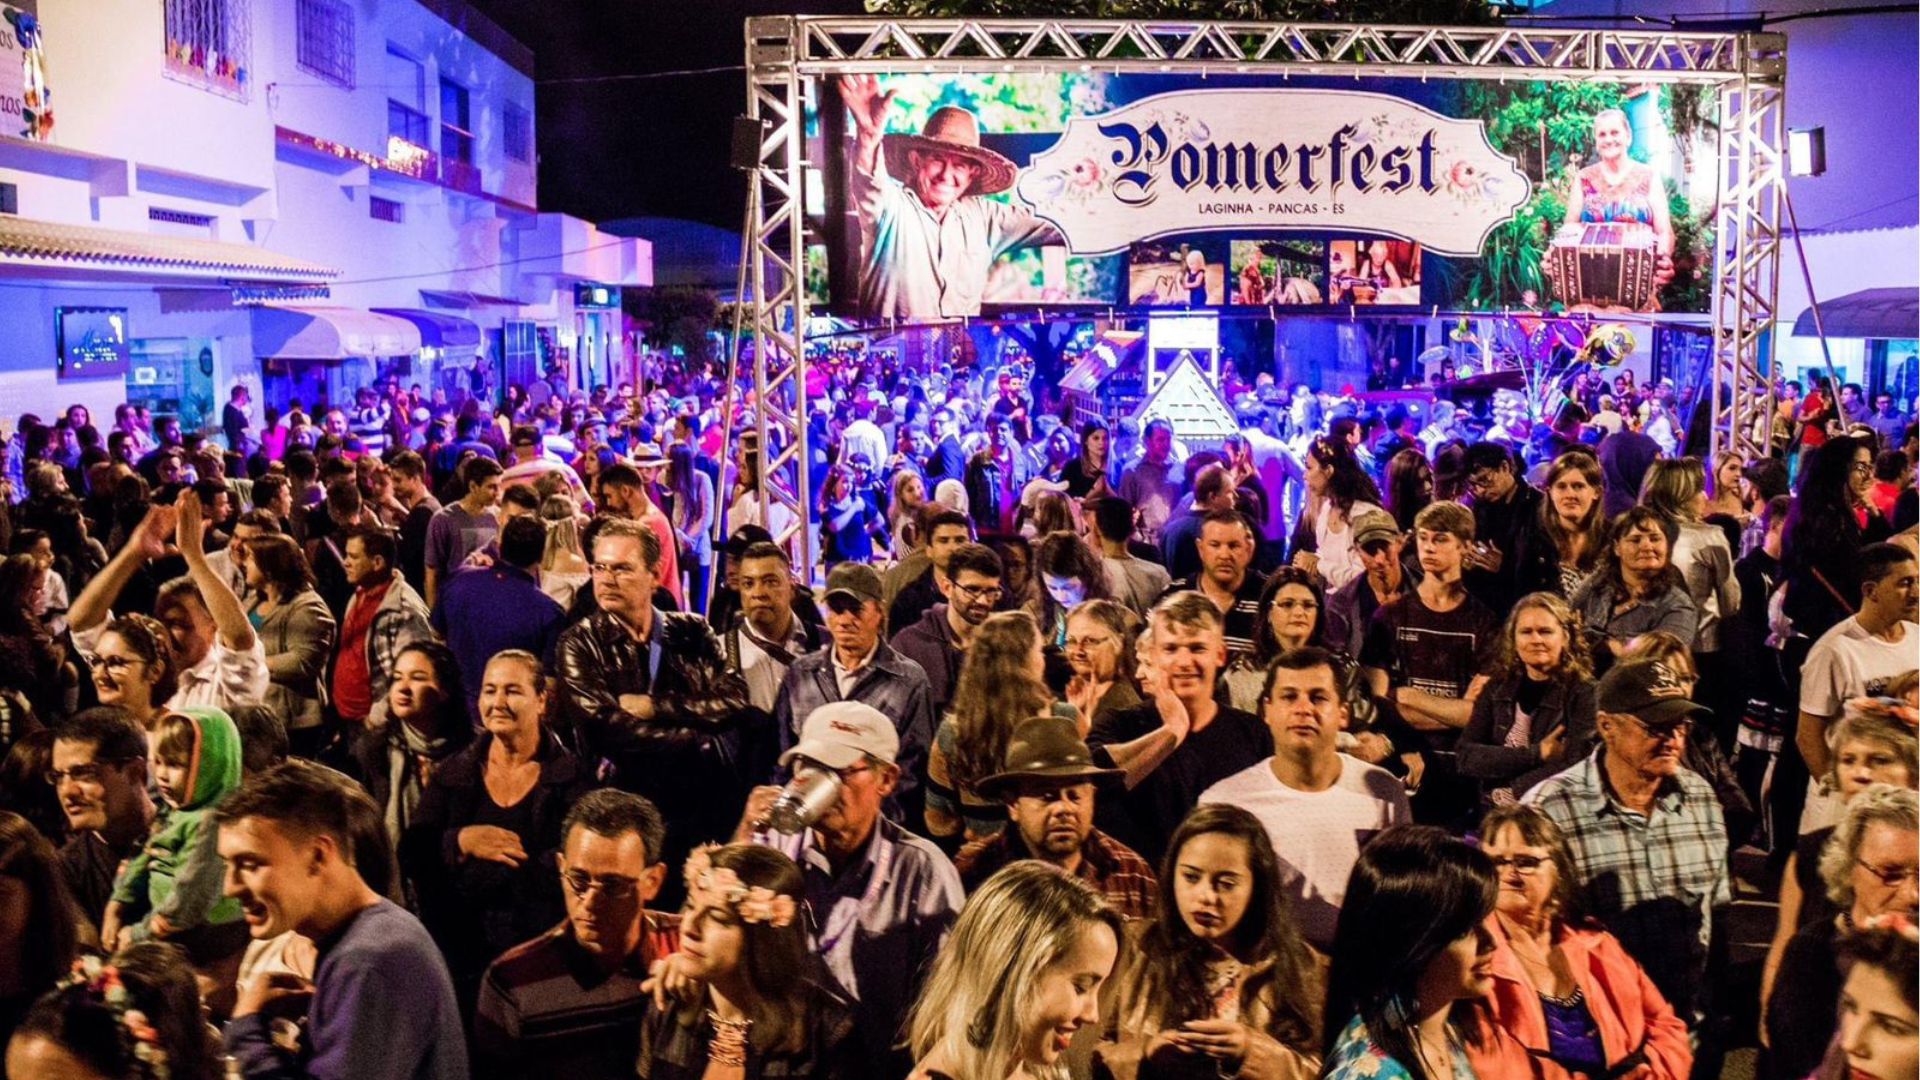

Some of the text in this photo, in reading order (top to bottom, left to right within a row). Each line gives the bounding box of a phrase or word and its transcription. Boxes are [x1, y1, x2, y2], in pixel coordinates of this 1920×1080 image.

[1097, 121, 1442, 207] Pomerfest
[1198, 203, 1253, 215] LAGINHA
[1268, 203, 1319, 215] PANCAS
[1332, 203, 1345, 215] ES
